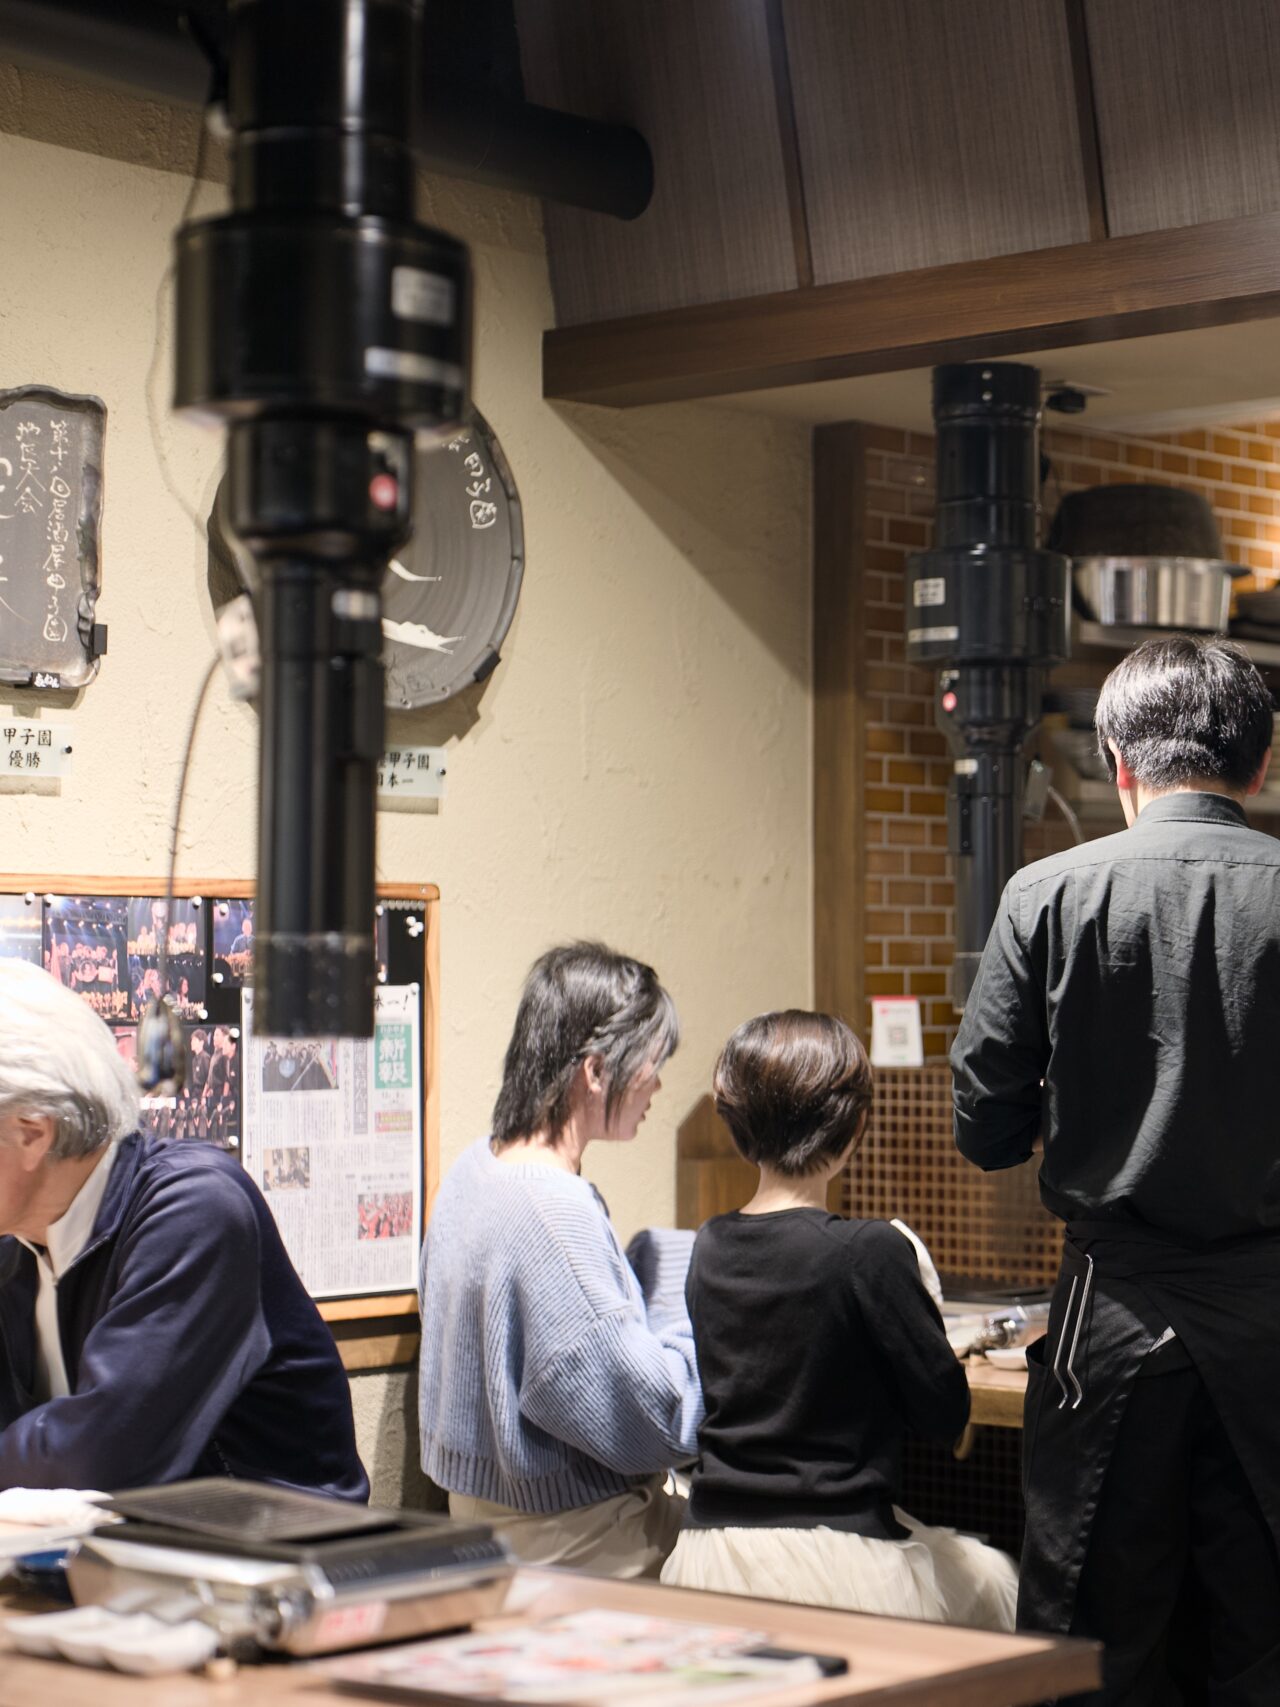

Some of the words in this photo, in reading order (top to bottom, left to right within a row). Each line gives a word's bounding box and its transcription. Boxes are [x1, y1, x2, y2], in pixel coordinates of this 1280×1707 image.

[3, 727, 52, 747] 甲子園
[9, 750, 41, 769] 優勝
